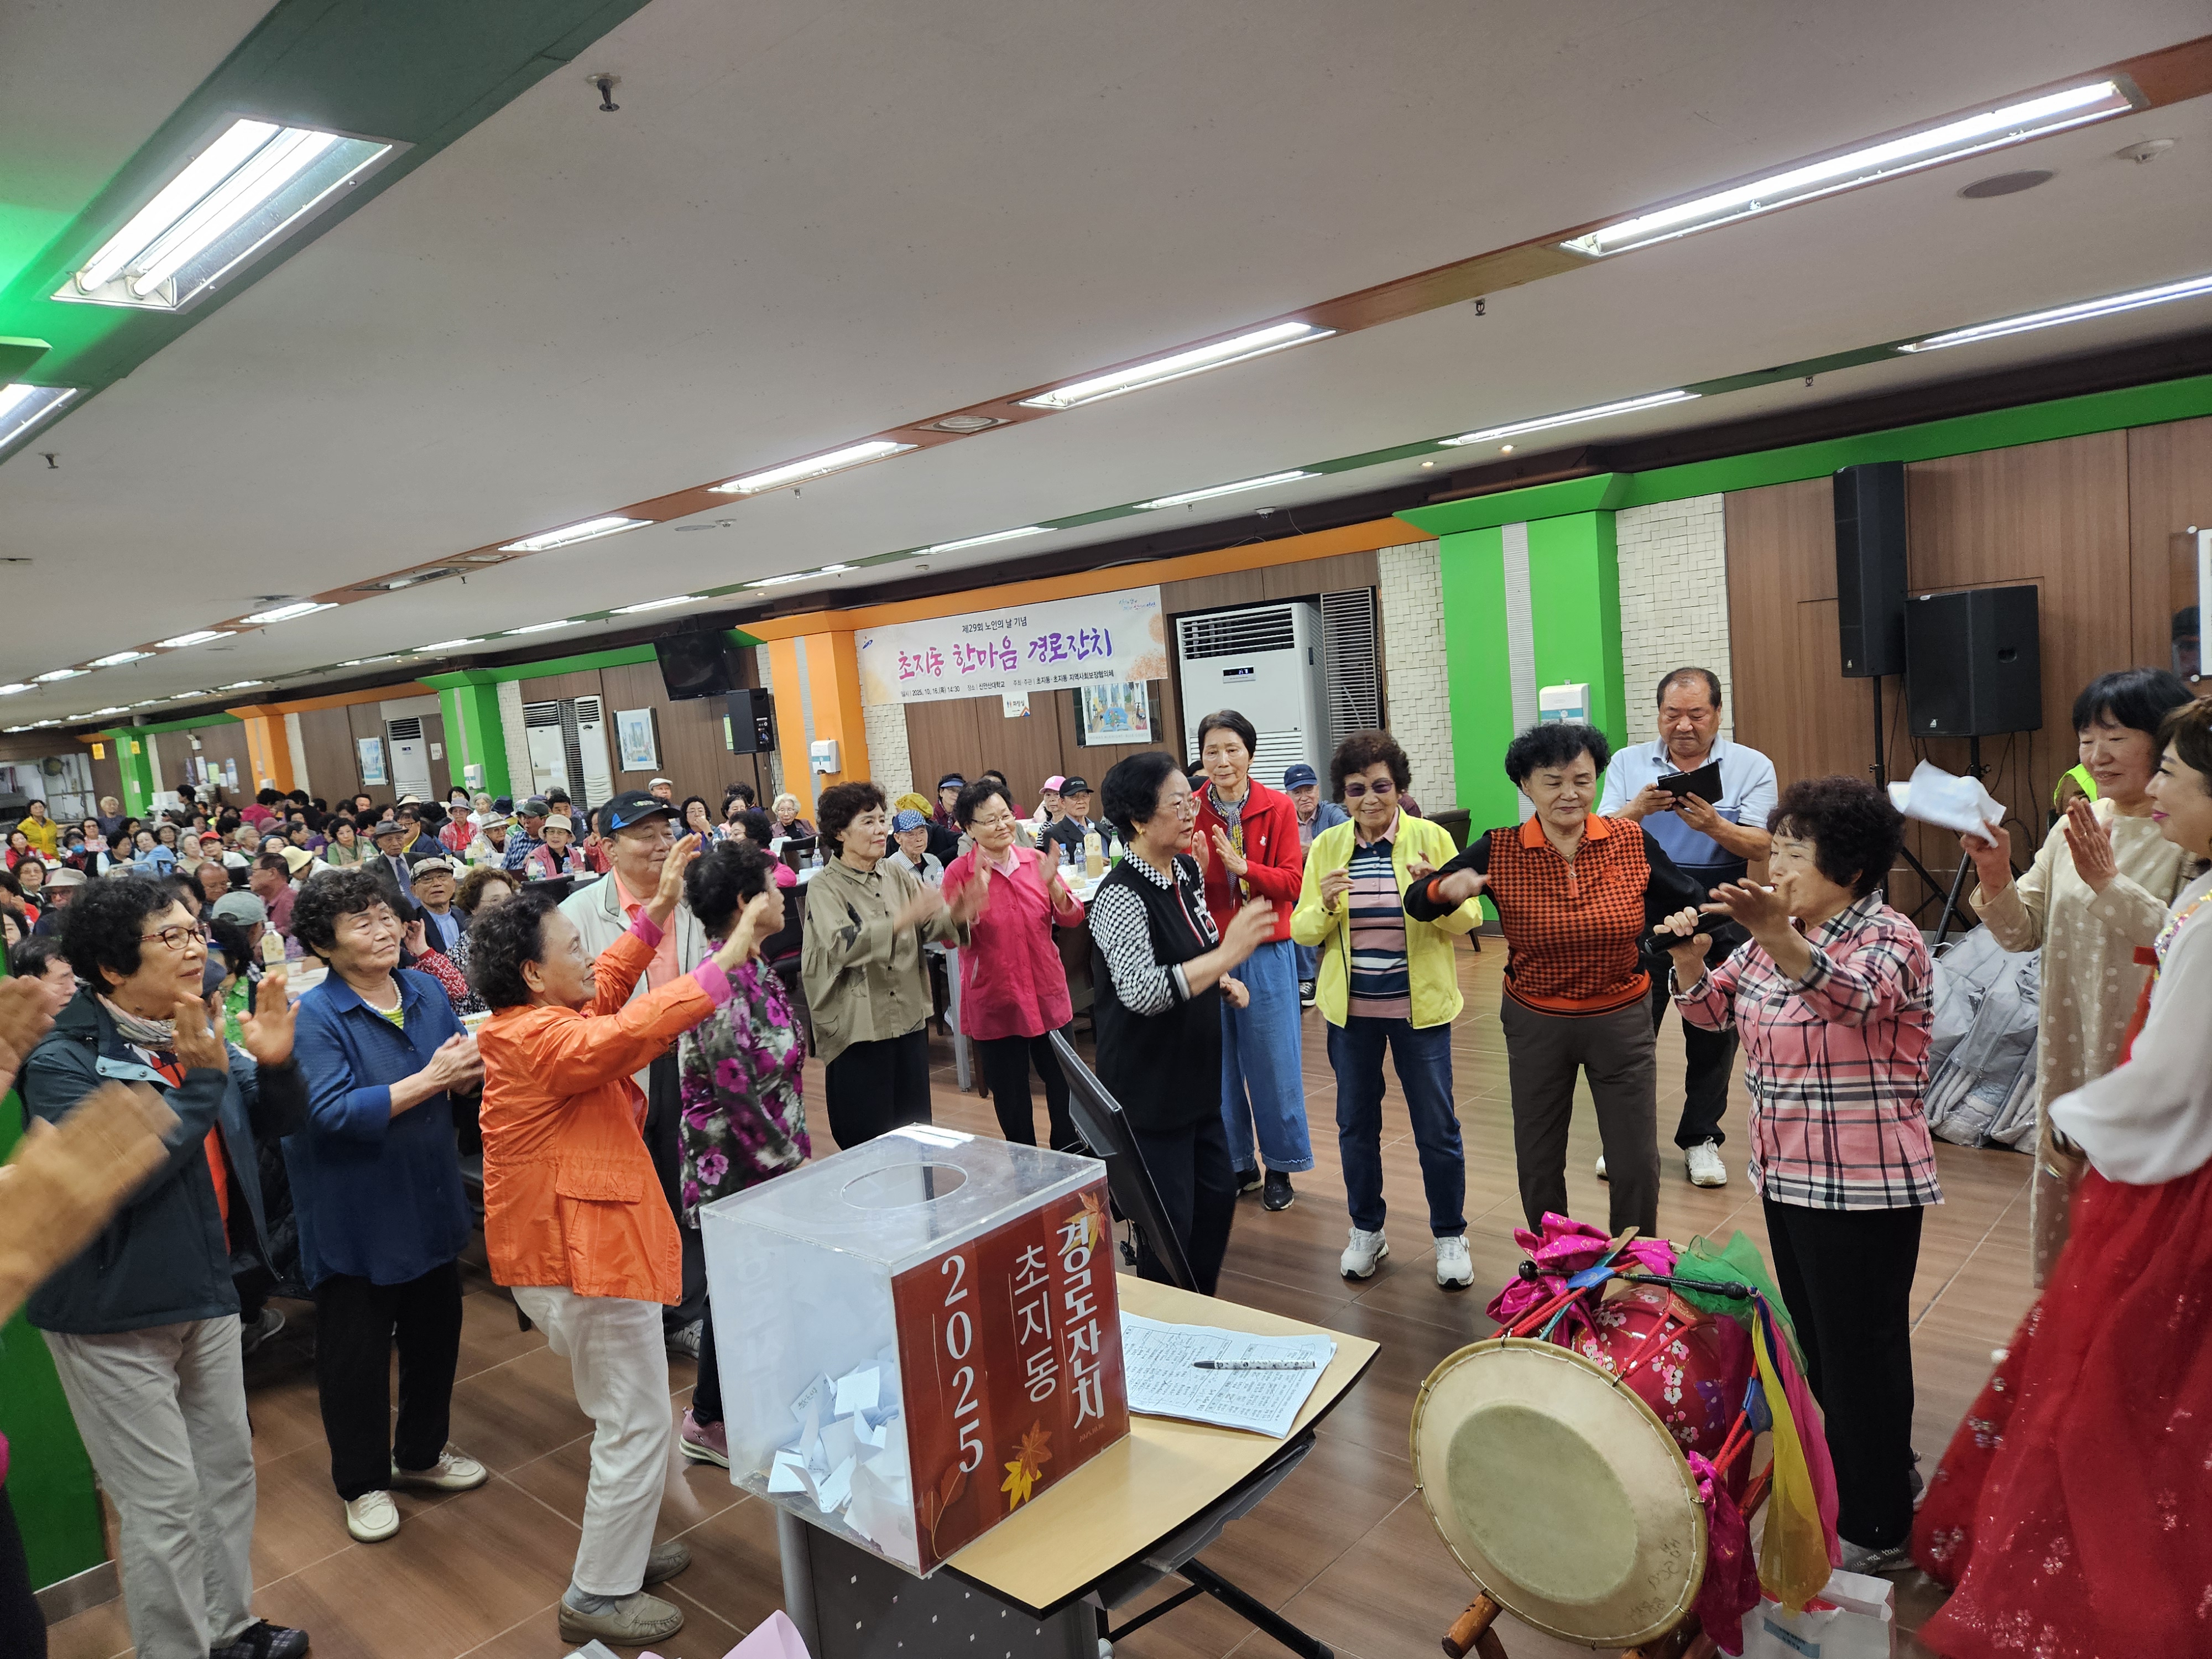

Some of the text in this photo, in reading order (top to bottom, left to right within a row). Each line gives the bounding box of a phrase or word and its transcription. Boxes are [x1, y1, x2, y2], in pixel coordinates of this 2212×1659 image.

[898, 628, 1112, 680] 초지동 한마음 경로잔치
[962, 616, 1027, 633] 제29회 노인의 날 기념
[979, 681, 1005, 690] 신안산대학교
[1069, 669, 1114, 681] 지역사회보장협의체
[942, 1255, 984, 1473] 2025
[1015, 1246, 1060, 1402] 초지동
[1057, 1217, 1104, 1429] 경로잔치
